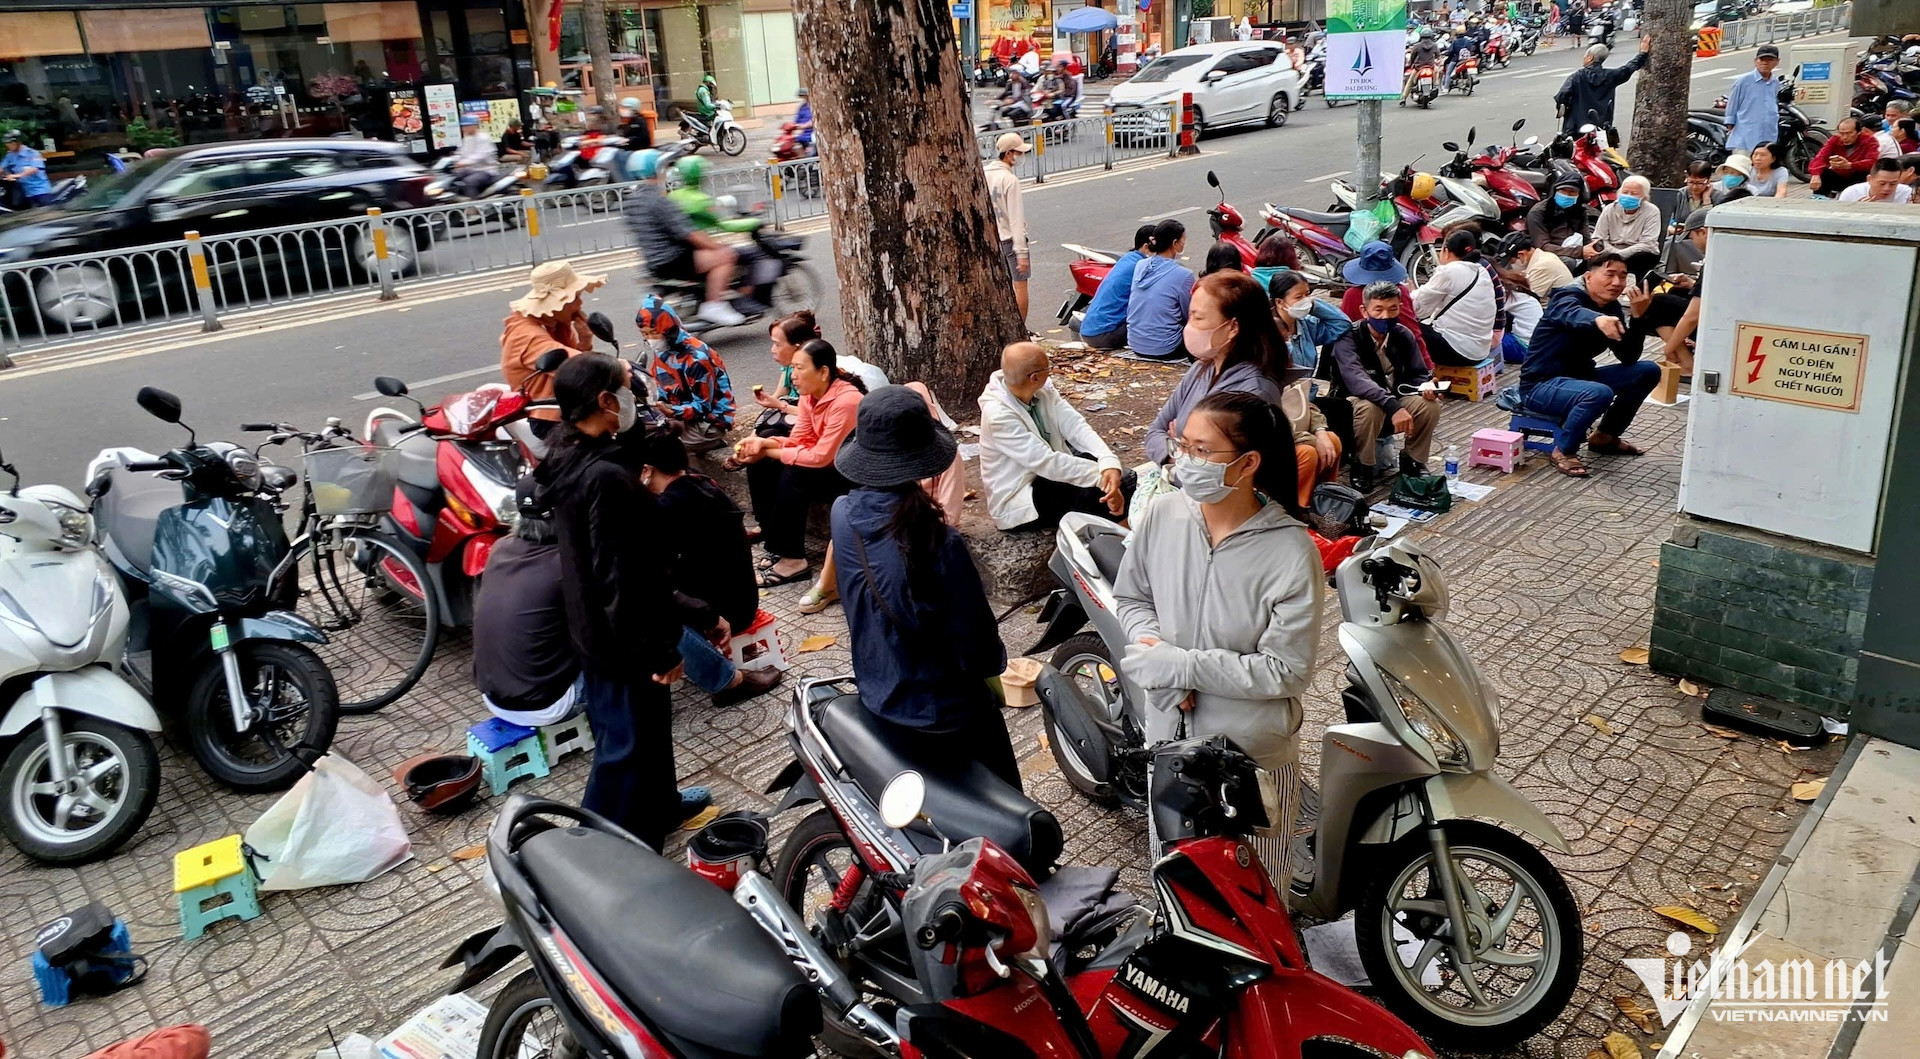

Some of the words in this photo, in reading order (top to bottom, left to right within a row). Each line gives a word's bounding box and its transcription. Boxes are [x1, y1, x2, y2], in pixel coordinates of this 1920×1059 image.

[1772, 337, 1799, 350] CẤM
[1801, 342, 1820, 354] LẠI
[1789, 355, 1805, 366] CÓ
[1807, 358, 1834, 371] ĐIỆN
[1779, 368, 1811, 379] NGUY
[1774, 379, 1803, 391] CHẾT
[1805, 383, 1843, 396] NGƯỜI
[1125, 962, 1190, 1014] YAMAHA
[1013, 993, 1039, 1013] HON
